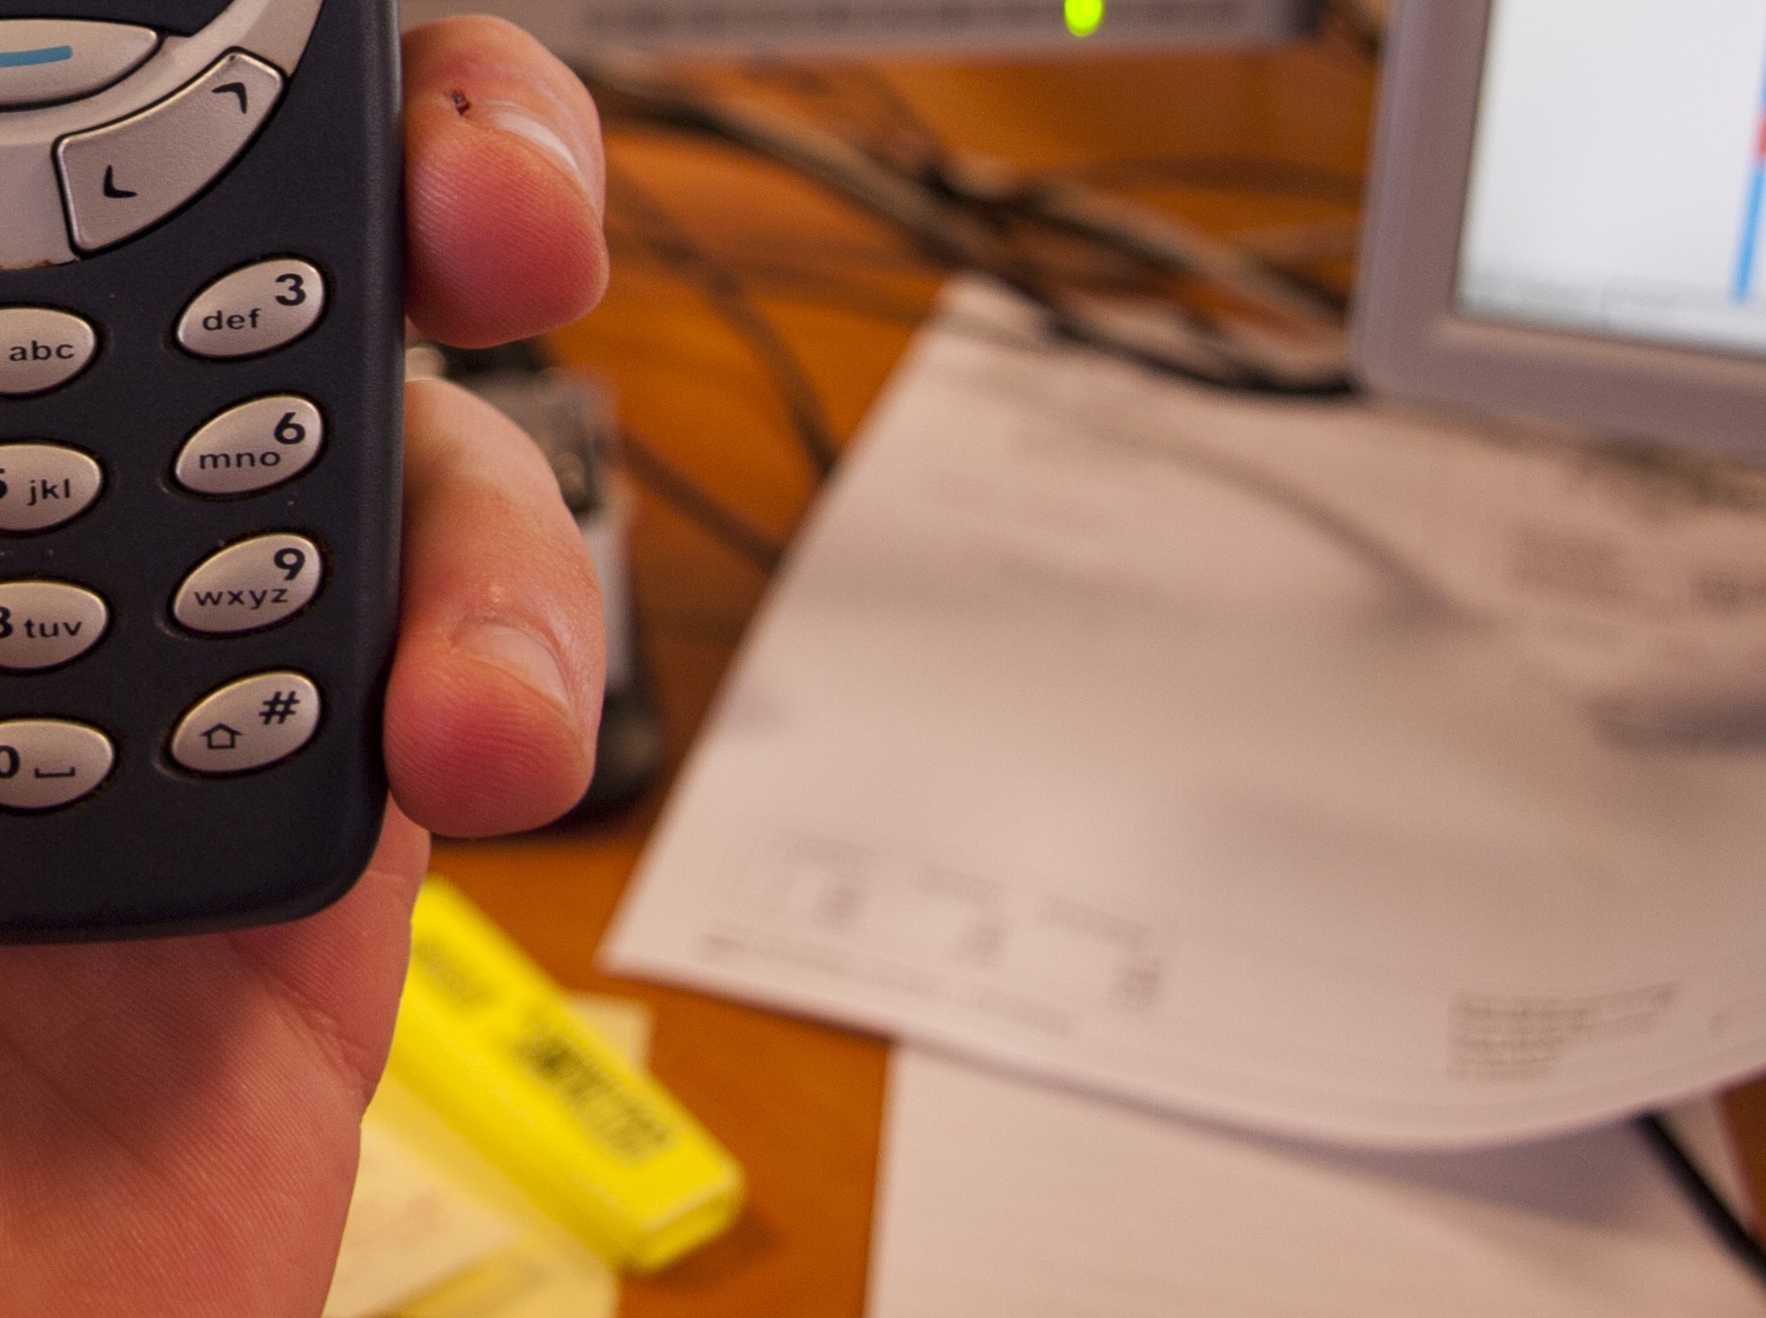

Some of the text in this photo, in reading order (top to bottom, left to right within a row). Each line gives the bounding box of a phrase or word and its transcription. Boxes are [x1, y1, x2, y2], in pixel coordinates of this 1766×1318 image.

[202, 273, 306, 332] def 3
[8, 340, 74, 362] abc
[199, 412, 306, 470] mno 6
[27, 478, 71, 507] jkl
[194, 547, 305, 611] wxyz 9
[23, 619, 82, 639] tuv
[258, 691, 300, 725] #
